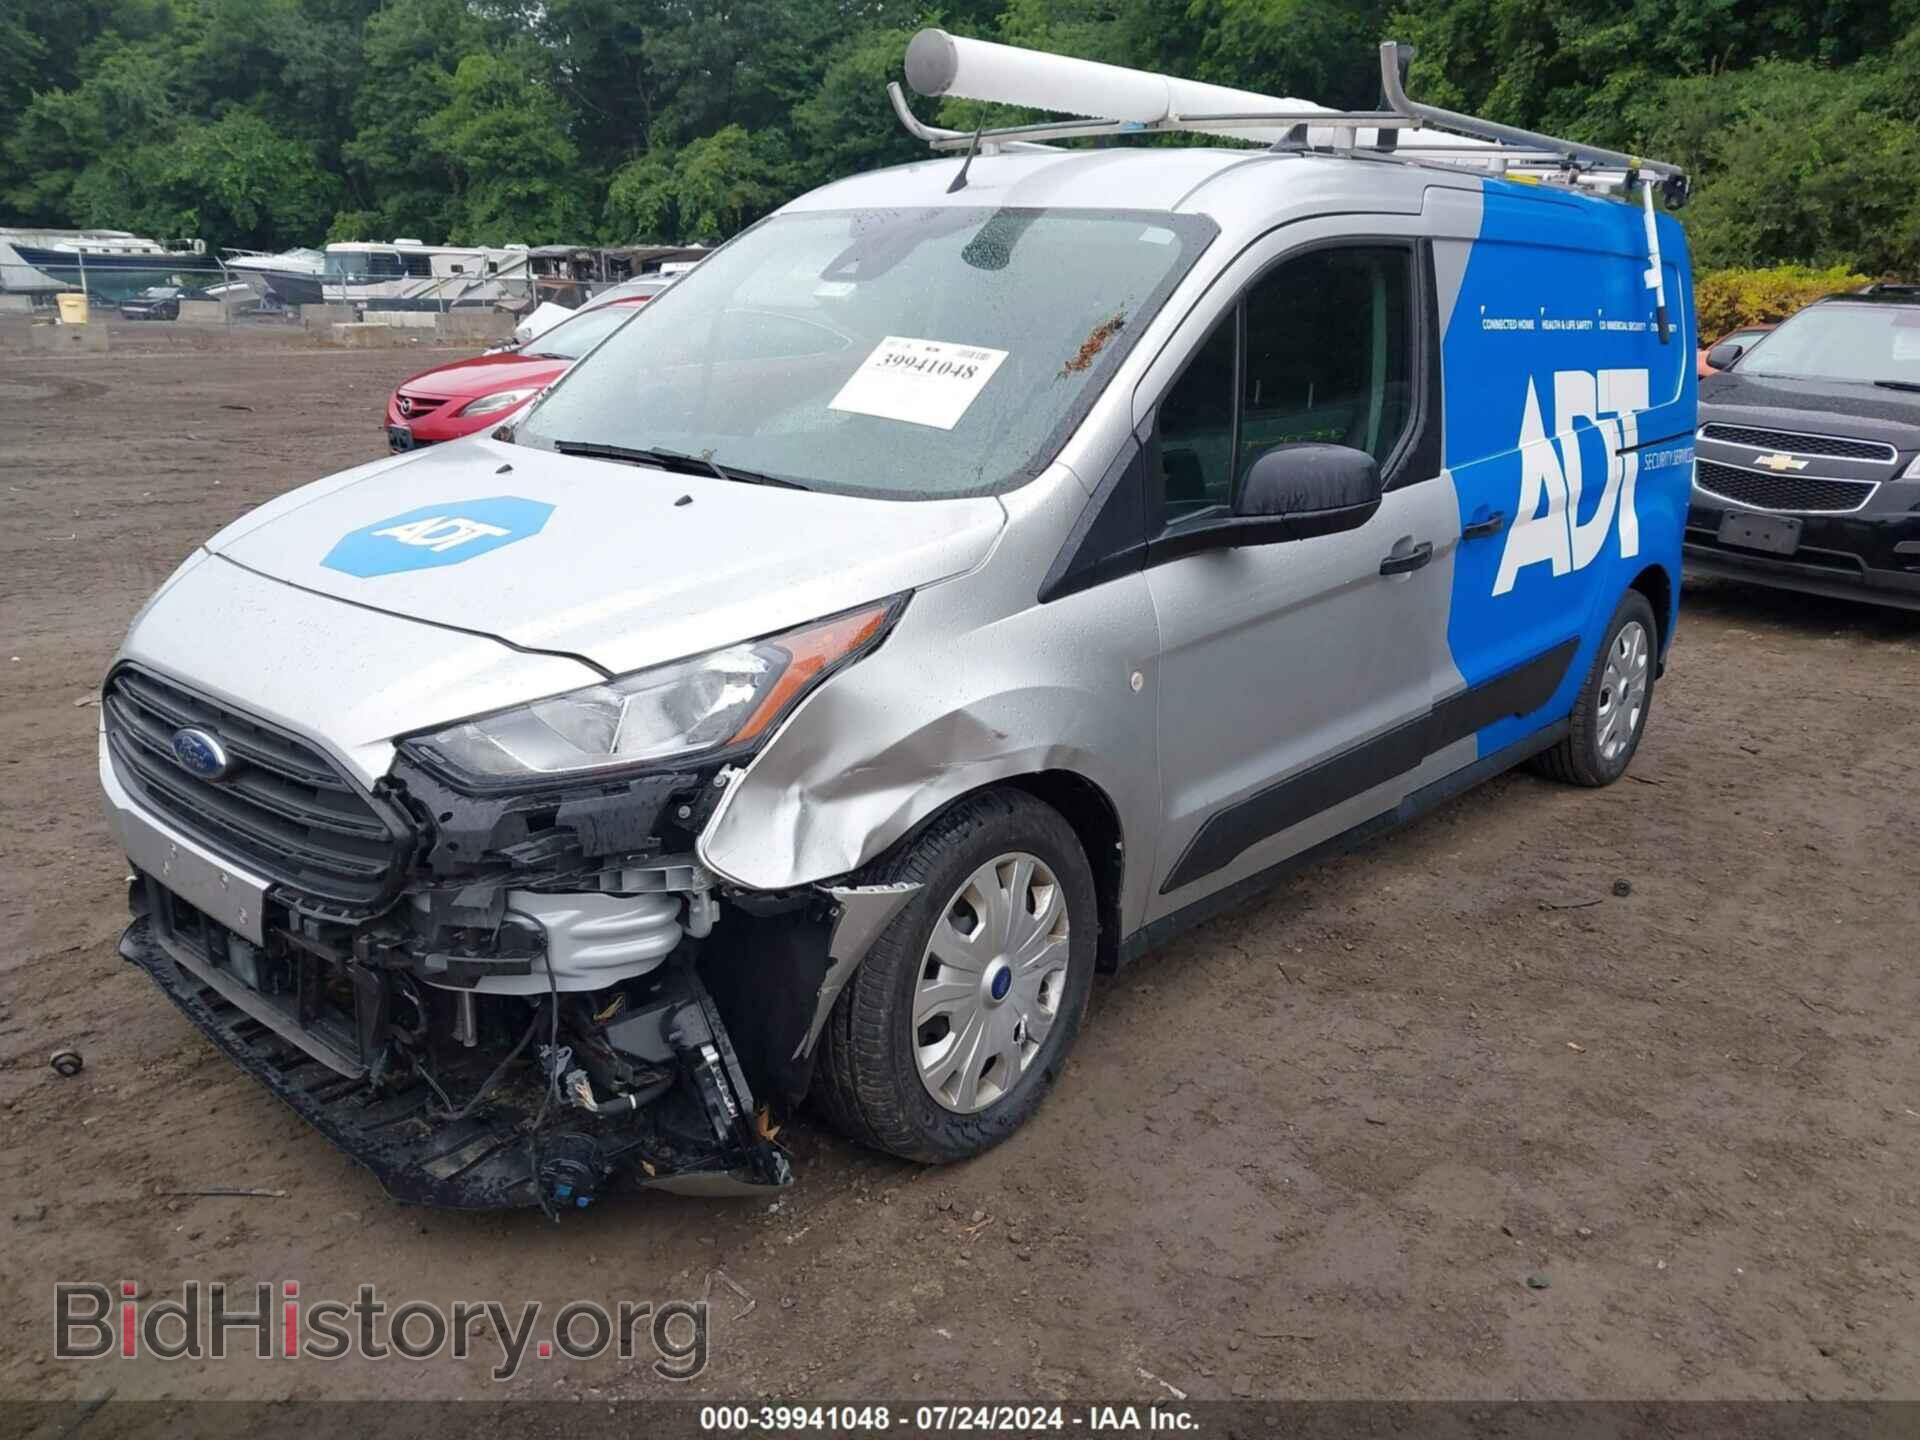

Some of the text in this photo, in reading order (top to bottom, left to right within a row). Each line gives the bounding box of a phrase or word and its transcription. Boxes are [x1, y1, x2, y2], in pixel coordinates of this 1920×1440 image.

[1482, 318, 1535, 330] CONNECTED HOME
[876, 352, 979, 380] 39941048
[1643, 449, 1672, 471] SECURITY
[1492, 368, 1650, 597] ADT
[370, 514, 513, 553] ADT
